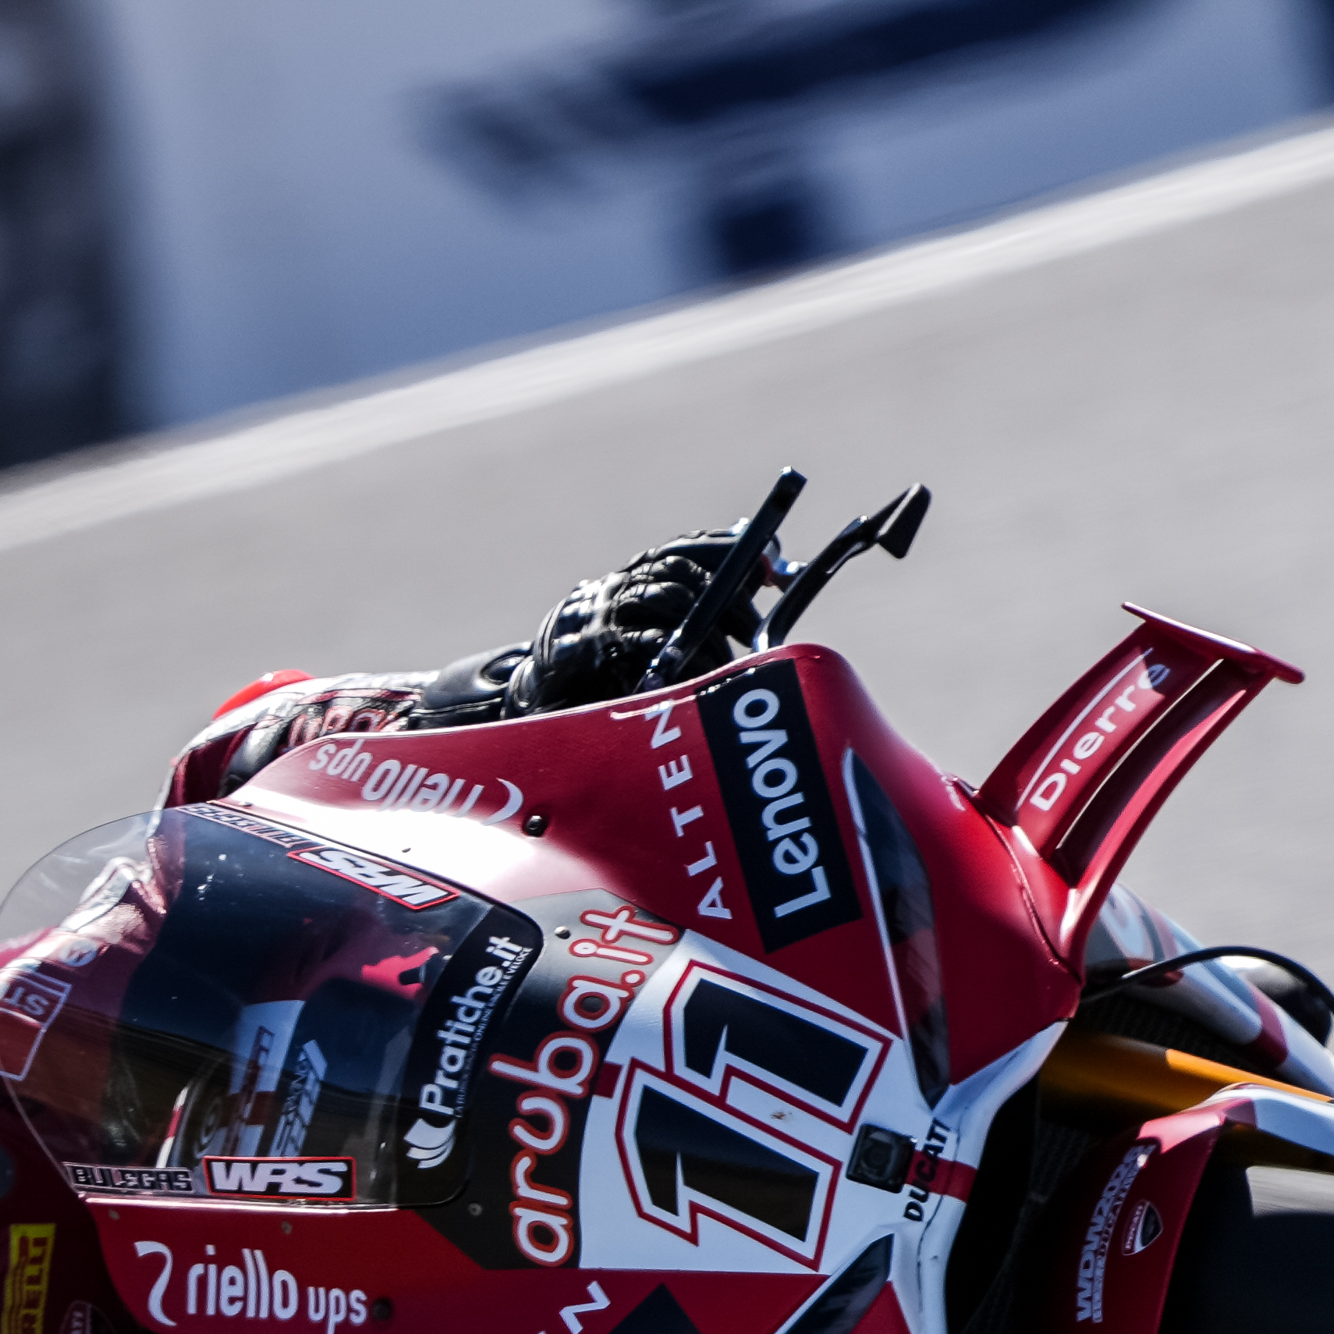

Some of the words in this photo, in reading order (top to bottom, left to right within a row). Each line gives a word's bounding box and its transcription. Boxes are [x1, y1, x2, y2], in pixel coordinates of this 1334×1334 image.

[309, 741, 366, 783] ups
[644, 699, 732, 920] ALTEN
[733, 688, 832, 918] Lenovo
[1030, 664, 1170, 811] Dierre
[299, 849, 449, 905] WRS
[418, 936, 523, 1114] Pratiche.it
[489, 906, 679, 1268] aruba.it
[210, 1160, 349, 1194] WRS
[622, 966, 885, 1260] 11
[904, 1119, 951, 1221] DUCATI
[186, 1244, 299, 1320] riello
